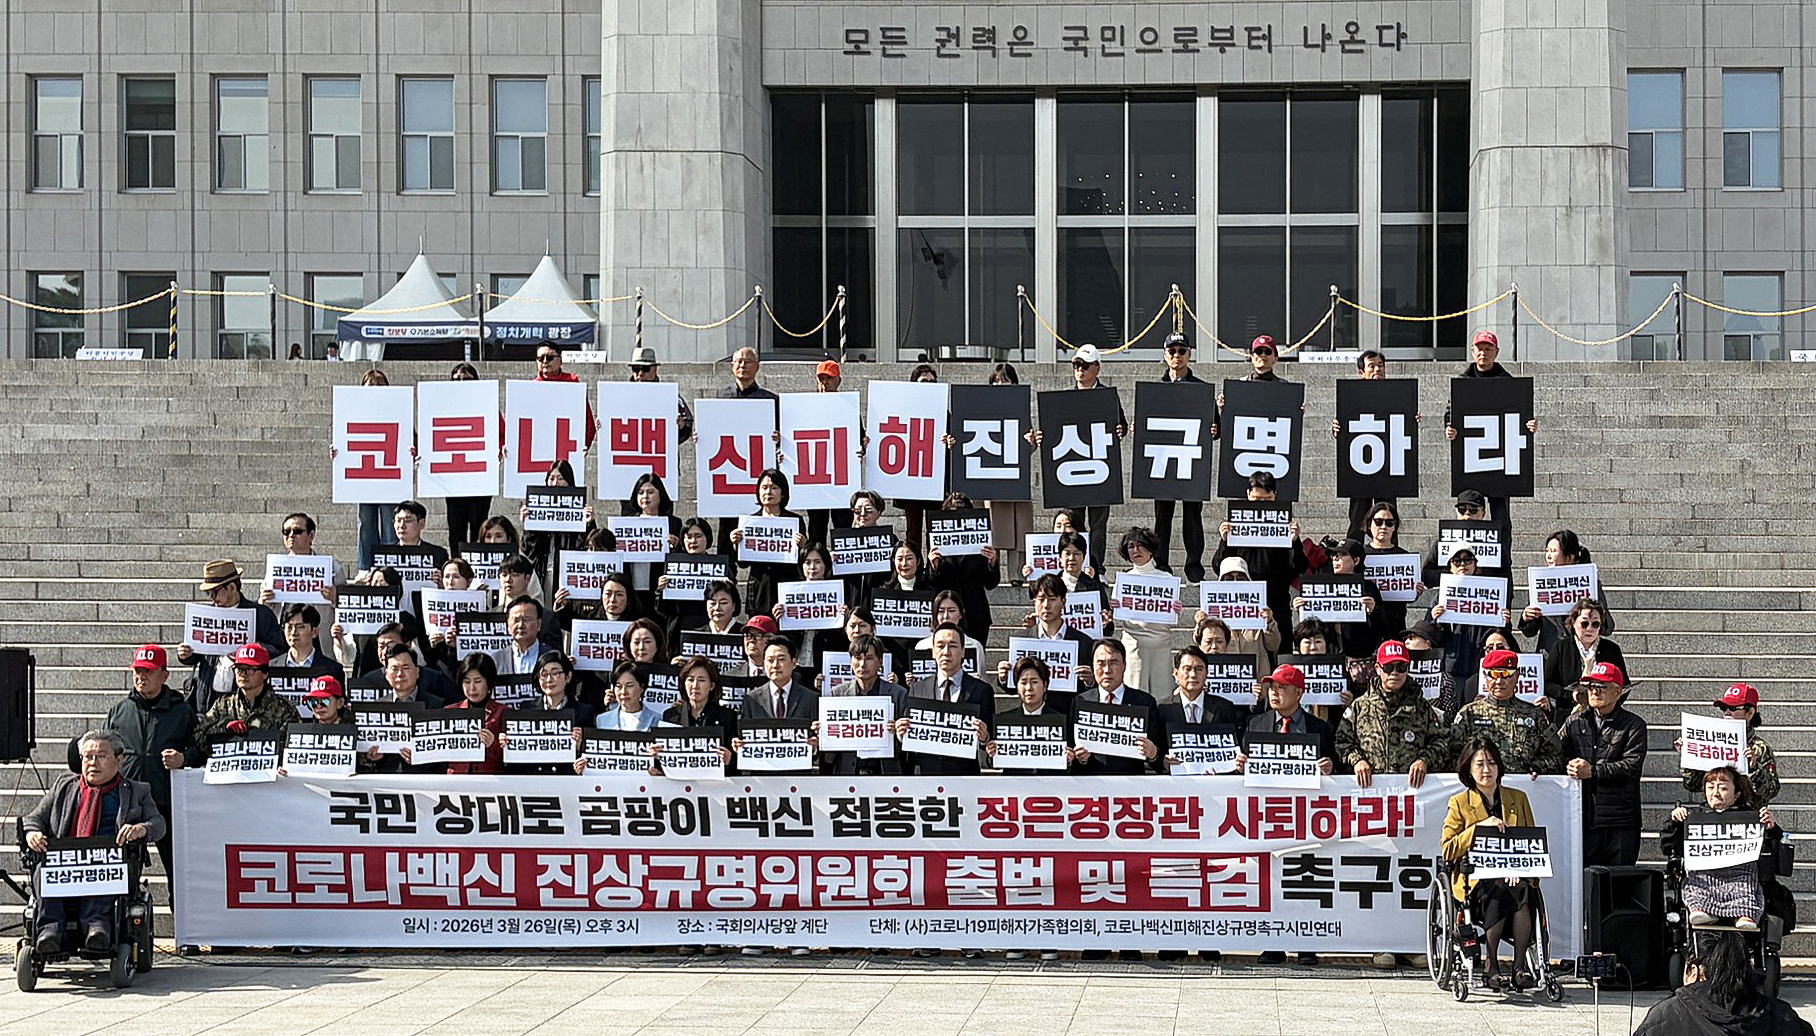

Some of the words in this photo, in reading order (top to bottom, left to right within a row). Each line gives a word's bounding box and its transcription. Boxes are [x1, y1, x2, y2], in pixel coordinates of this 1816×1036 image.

[843, 26, 909, 57] 모든
[934, 25, 1035, 58] 권력은
[1062, 25, 1273, 58] 국민으로부터
[1303, 22, 1408, 55] 나온다
[496, 327, 543, 339] 정치개혁
[547, 326, 572, 339] 광장
[528, 494, 584, 508] 코로나백신
[528, 510, 584, 522] 진상규명하라
[1231, 509, 1289, 523] 코로나백신
[931, 518, 988, 532] 코로나백신
[1231, 525, 1289, 537] 진상규명하라
[614, 527, 663, 538] 코로나백신
[744, 526, 793, 539] 코로나백신
[932, 533, 990, 546] 진상규명하라
[745, 540, 792, 553] 특검하라
[834, 535, 892, 550] 코로나백신
[1441, 544, 1498, 557] 진하라
[374, 553, 434, 568] 코로나백신
[461, 552, 504, 565] 코로나백
[273, 566, 325, 578] 코로나백신
[566, 562, 616, 574] 코로나백신
[666, 562, 726, 576] 코로나백신
[566, 575, 603, 589] 특검하
[1375, 579, 1415, 592] 검하라
[1535, 576, 1590, 590] 코로나백신
[1121, 584, 1174, 599] 코로나백신
[1302, 583, 1361, 597] 코로나백신
[1446, 586, 1500, 600] 코로나백신
[338, 594, 396, 609] 코로나백신
[785, 591, 838, 605] 코로나백신
[873, 598, 933, 612] 코로나백신
[1121, 597, 1172, 613] 특검하라
[1207, 592, 1260, 604] 코로나백신
[427, 600, 479, 613] 코로나백신
[786, 605, 838, 619] 특검하라
[1208, 606, 1260, 619] 특검하라
[1446, 600, 1499, 615] 특검하라
[192, 616, 249, 631] 코로나백신
[338, 611, 396, 624] 진상규명하라
[459, 622, 508, 636] 코로나백
[460, 637, 513, 650] 진상규명하
[578, 632, 622, 643] 코로나백
[682, 642, 743, 658] 코로나백신
[1385, 645, 1402, 656] KLO
[1206, 664, 1253, 678] 로나백신
[1204, 682, 1253, 694] 상규명하라
[355, 711, 411, 726] 코로나백
[826, 709, 884, 723] 코로나백신
[910, 707, 977, 731] 코로나백신
[1078, 711, 1144, 732] 코로나백신
[415, 719, 482, 736] 코로나백신
[506, 720, 571, 735] 코로나백신
[827, 723, 884, 739] 특검하라
[996, 725, 1063, 741] 코로나백신
[288, 733, 353, 749] 코로나백신
[357, 729, 411, 742] 진상규명하
[741, 729, 808, 743] 코로나백신
[907, 726, 975, 747] 진상규명하라
[1171, 733, 1236, 748] 코로나백신
[1686, 727, 1739, 746] 코로나백신
[212, 740, 276, 757] 코로나백신
[742, 744, 808, 758] 진상규명하라
[997, 743, 1063, 757] 진상규명하라
[1249, 744, 1317, 759] 코로나백신
[1687, 742, 1740, 762] 특검하라
[210, 758, 274, 772] 진상규명하라
[287, 752, 352, 765] 진상규명하라
[1249, 761, 1317, 776] 진상규명하라
[330, 790, 417, 834] 국민
[434, 795, 565, 836] 상대로
[579, 795, 712, 837] 곰팡이
[726, 796, 814, 838] 백신
[829, 796, 964, 839] 접종한
[977, 796, 1203, 840] 정은경장관
[1218, 795, 1416, 840] 사퇴하라!
[1688, 823, 1761, 840] 코로나백신
[1474, 837, 1544, 854] 코로나백신
[1689, 842, 1758, 857] 진상규명하라
[46, 847, 124, 865] 코로나백신
[1473, 855, 1546, 870] 진상규명하라
[45, 867, 124, 884] 진상규명하라
[238, 850, 517, 907] 코로나백신
[536, 852, 926, 909] 진상규명위원회
[945, 854, 1055, 907] 출범
[1078, 859, 1127, 904] 및
[1148, 854, 1260, 908] 특검
[402, 918, 430, 934] 일시
[441, 918, 493, 934] 2026년
[497, 918, 520, 934] 3월
[524, 918, 582, 935] 26일(목)
[585, 918, 613, 934] 오후
[616, 918, 639, 934] 3시
[677, 918, 705, 934] 장소
[715, 918, 798, 934] 국회의사당앞
[801, 918, 828, 934] 계단
[869, 918, 900, 934] 단체:
[1104, 918, 1342, 938] 코로나백신피해진상규명촉구시민연대
